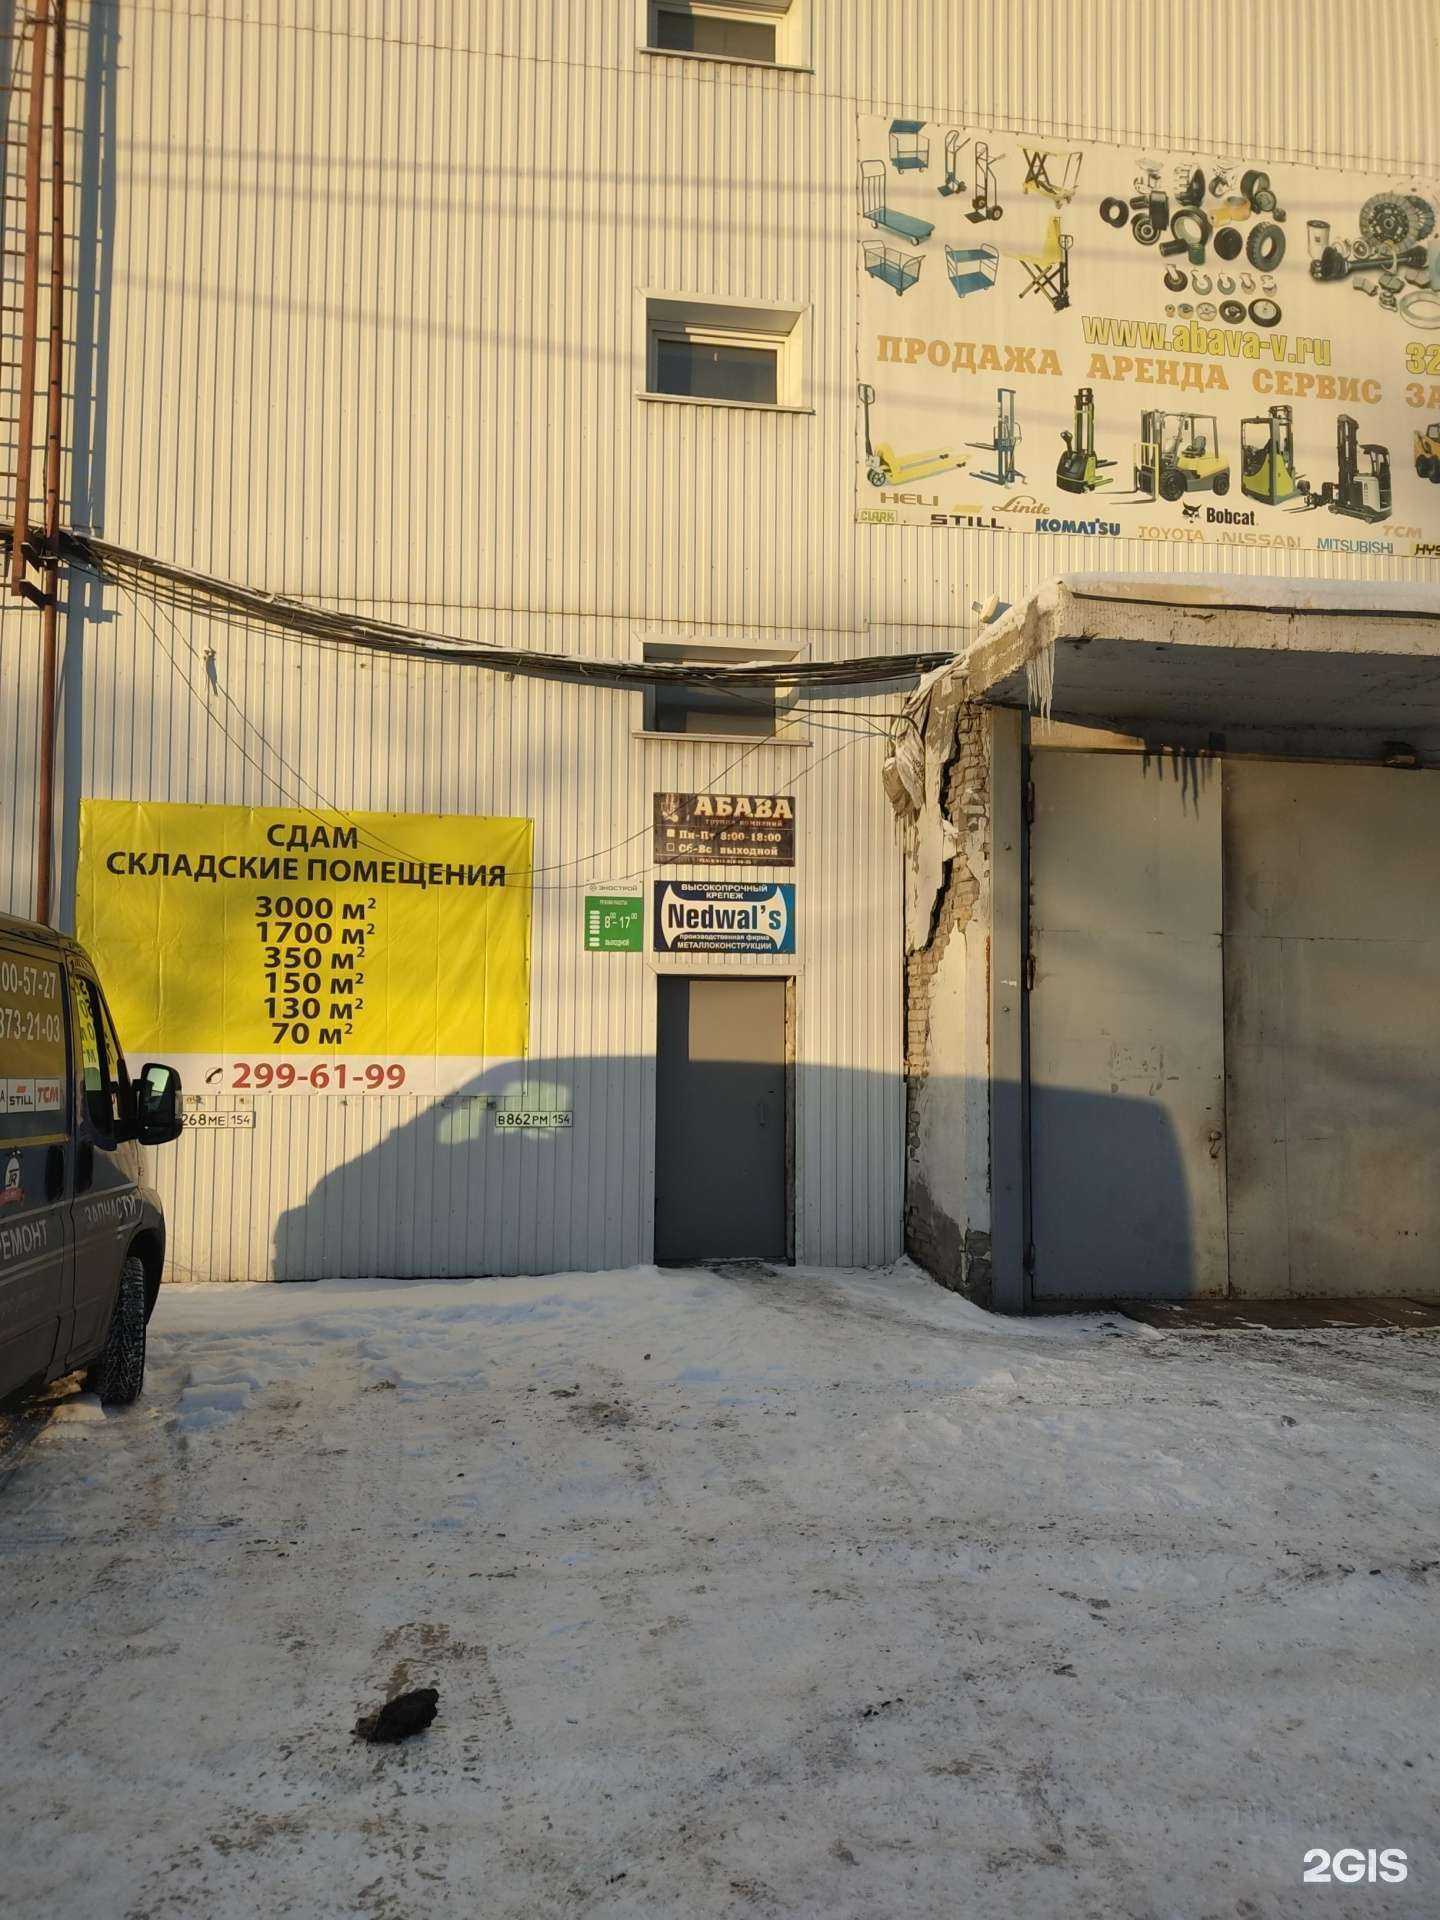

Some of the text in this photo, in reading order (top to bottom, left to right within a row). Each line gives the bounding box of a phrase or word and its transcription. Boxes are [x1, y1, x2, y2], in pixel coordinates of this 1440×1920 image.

[1081, 315, 1333, 367] www.abava-v.ru
[876, 335, 1063, 376] ПРОДАЖА
[1086, 352, 1230, 394] АРЕНДА
[1252, 367, 1383, 404] СЕРВИС
[880, 492, 939, 506] HELI
[992, 495, 1050, 515] Linde
[860, 510, 896, 522] CLARK
[930, 513, 1005, 530] STILL
[1206, 507, 1255, 526] Bobcat
[1035, 518, 1121, 536] KOMATSU
[1138, 526, 1205, 543] TOYOTA
[1382, 525, 1422, 539] TCM
[1222, 531, 1301, 548] NISSAN
[1317, 537, 1393, 554] MITSUBISHI
[694, 796, 793, 819] АБАВА
[266, 823, 359, 852] СДАМ
[679, 830, 782, 842] Пн-Пт 8:00-18:00
[678, 843, 778, 857] Сб-Вс выходной
[106, 851, 507, 890] СКЛАДСКИЕ ПОМЕЩЕНИЯ
[681, 883, 768, 892] ВЫСОКОПРОЧНЫЙ
[706, 891, 744, 900] КРЕПЕЖ
[254, 896, 333, 920] 3000
[668, 903, 781, 930] Nedwal's
[255, 922, 332, 945] 1700
[680, 934, 770, 942] производственная фирма
[678, 941, 772, 950] МЕТАЛЛОКОНСТРУКЦИИ
[264, 946, 322, 970] 350
[1, 961, 57, 1000] 00-57-27
[265, 971, 321, 995] 150
[264, 997, 320, 1020] 130
[271, 1022, 310, 1045] 70
[231, 1063, 407, 1090] 299-61-99
[9, 1096, 33, 1106] STILL
[37, 1086, 59, 1104] TCM
[230, 1114, 251, 1125] 154
[552, 1114, 570, 1125] 154
[0, 1219, 48, 1260] ЕМОНТ
